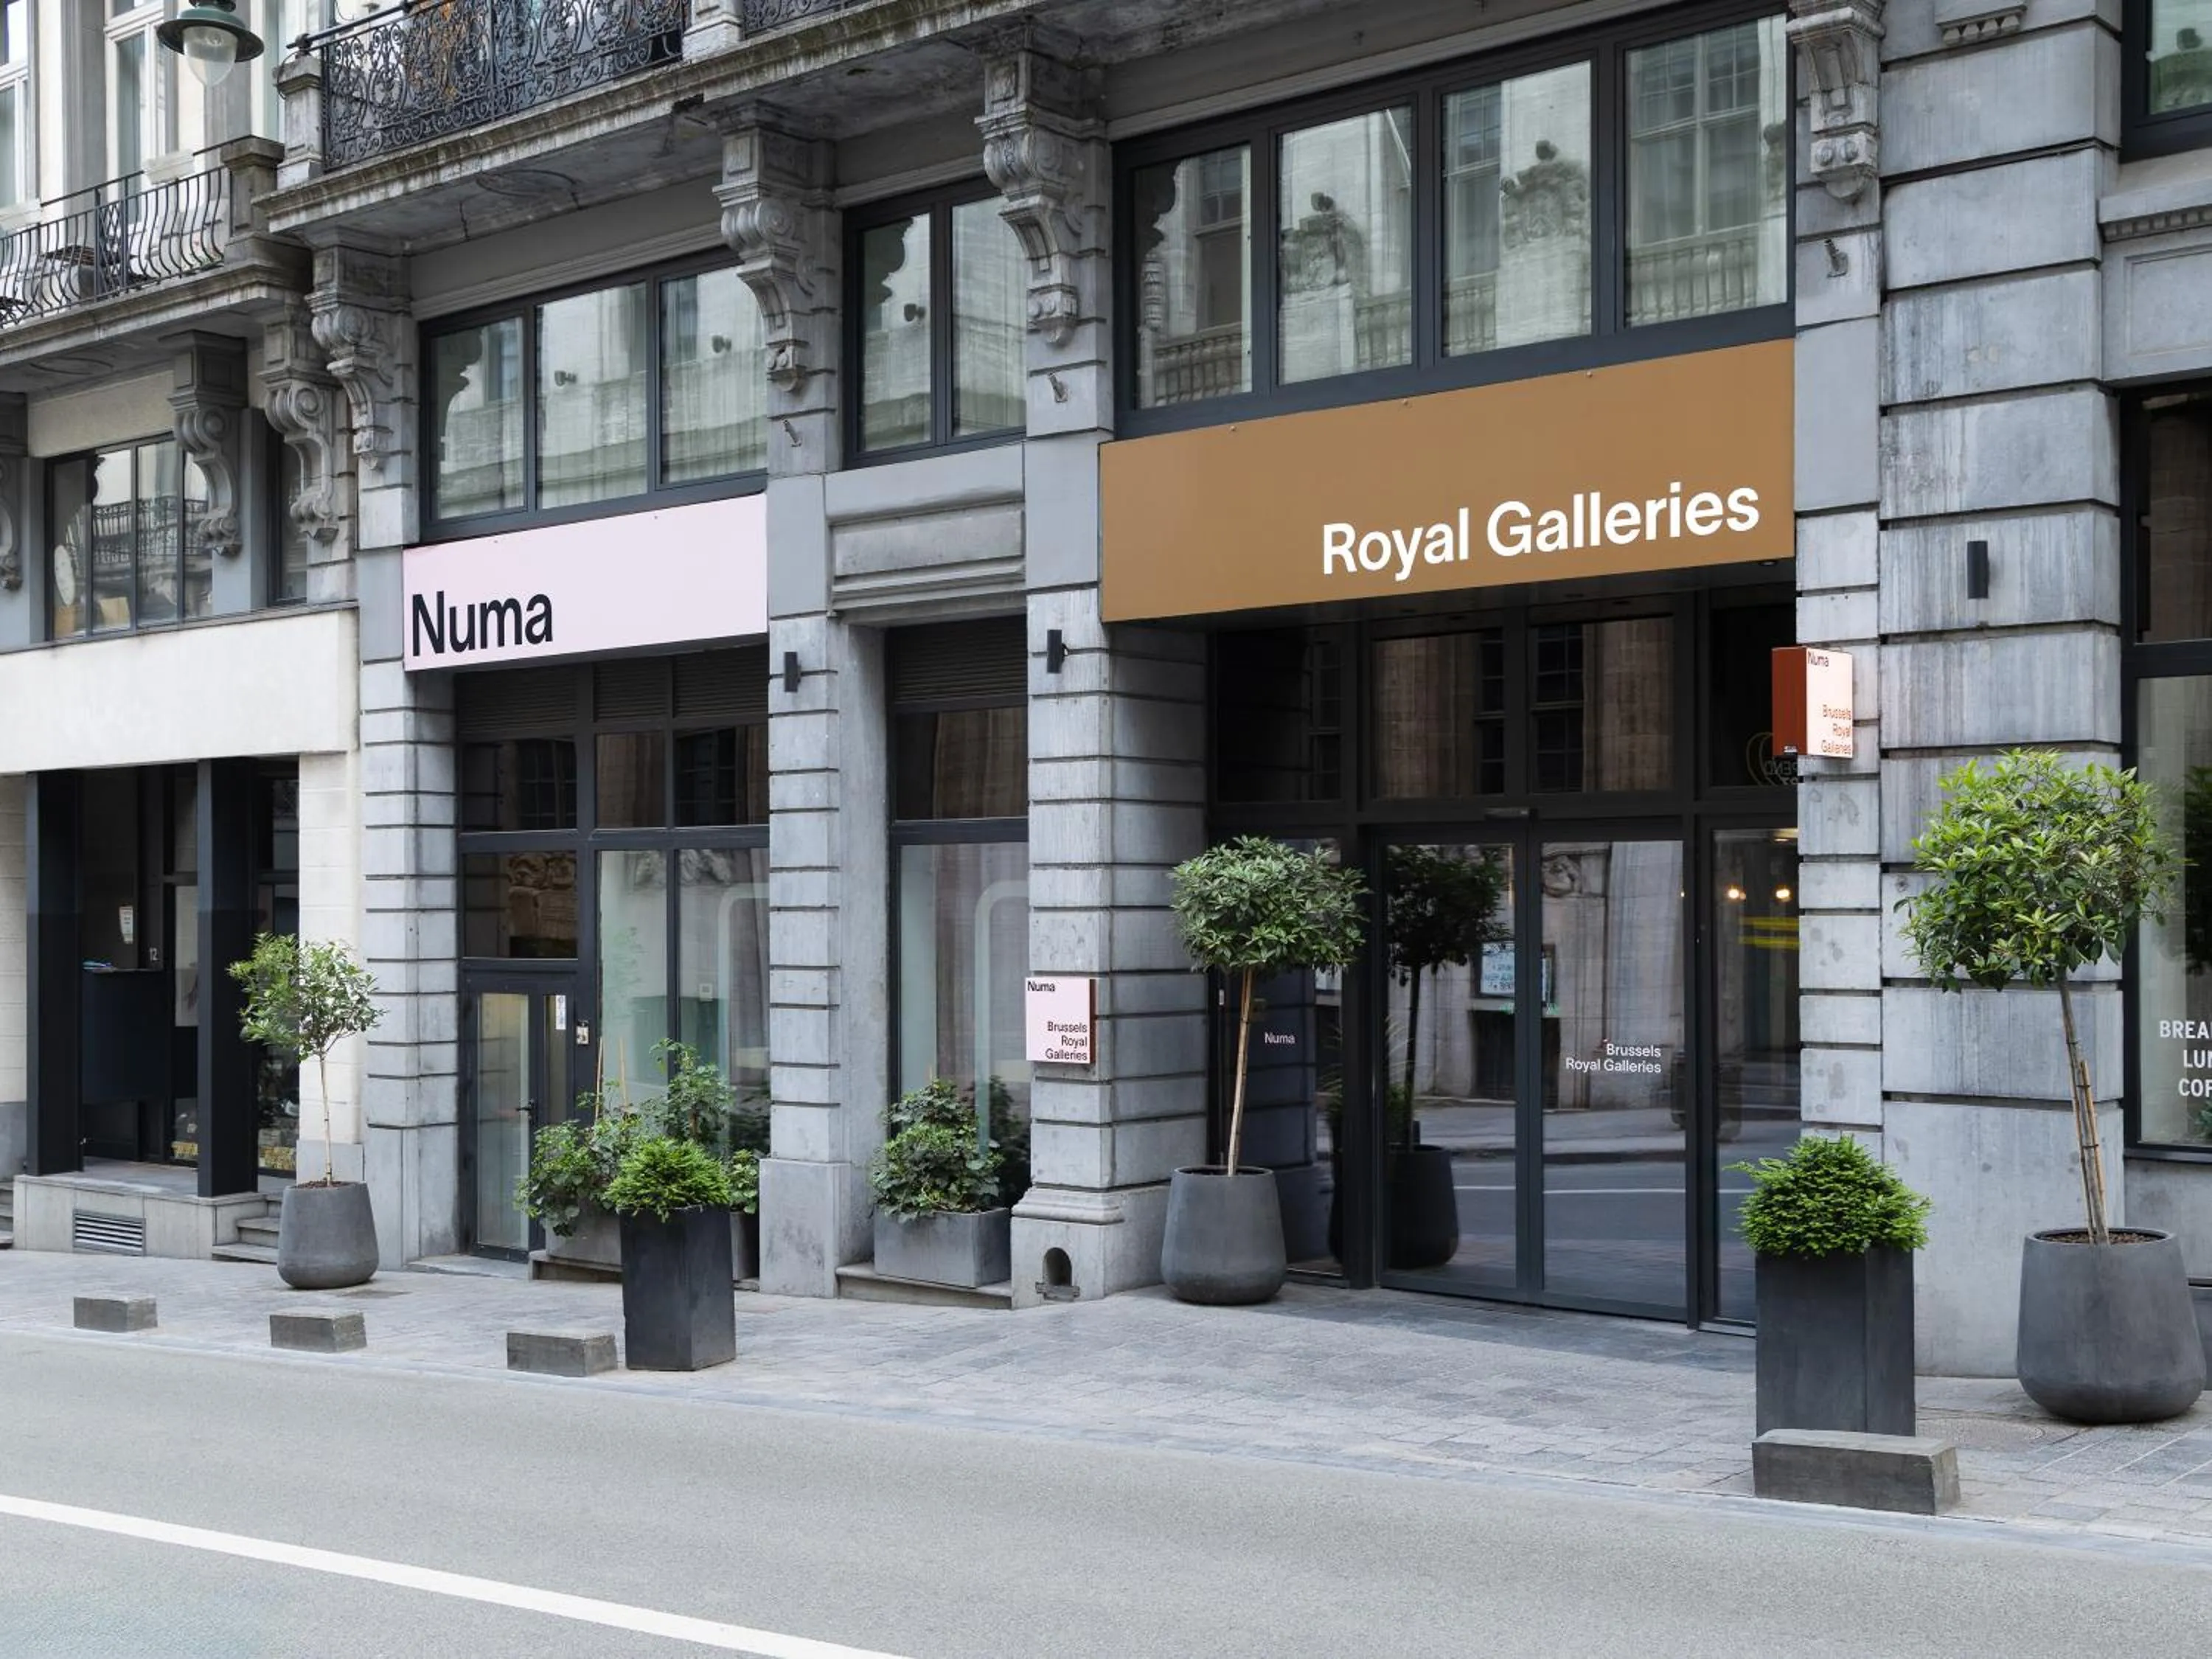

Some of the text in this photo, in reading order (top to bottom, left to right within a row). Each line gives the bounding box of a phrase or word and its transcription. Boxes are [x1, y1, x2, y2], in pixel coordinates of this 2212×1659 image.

[1323, 481, 1760, 582] Royal Galleries
[412, 591, 552, 657] Numa
[1807, 651, 1829, 667] Numa
[1822, 704, 1851, 720] Brussels
[1833, 723, 1851, 740] Royal
[1821, 740, 1851, 756] Galleries
[149, 947, 158, 961] 12
[1027, 981, 1056, 992] Numa
[1047, 1020, 1088, 1033] Brussels
[2159, 1020, 2212, 1039] BREA
[1061, 1034, 1088, 1048] Royal
[1265, 1032, 1295, 1044] Numa
[1046, 1048, 1088, 1061] Galleries
[1606, 1043, 1661, 1057] Brussels
[1565, 1057, 1661, 1073] Royal Galleries
